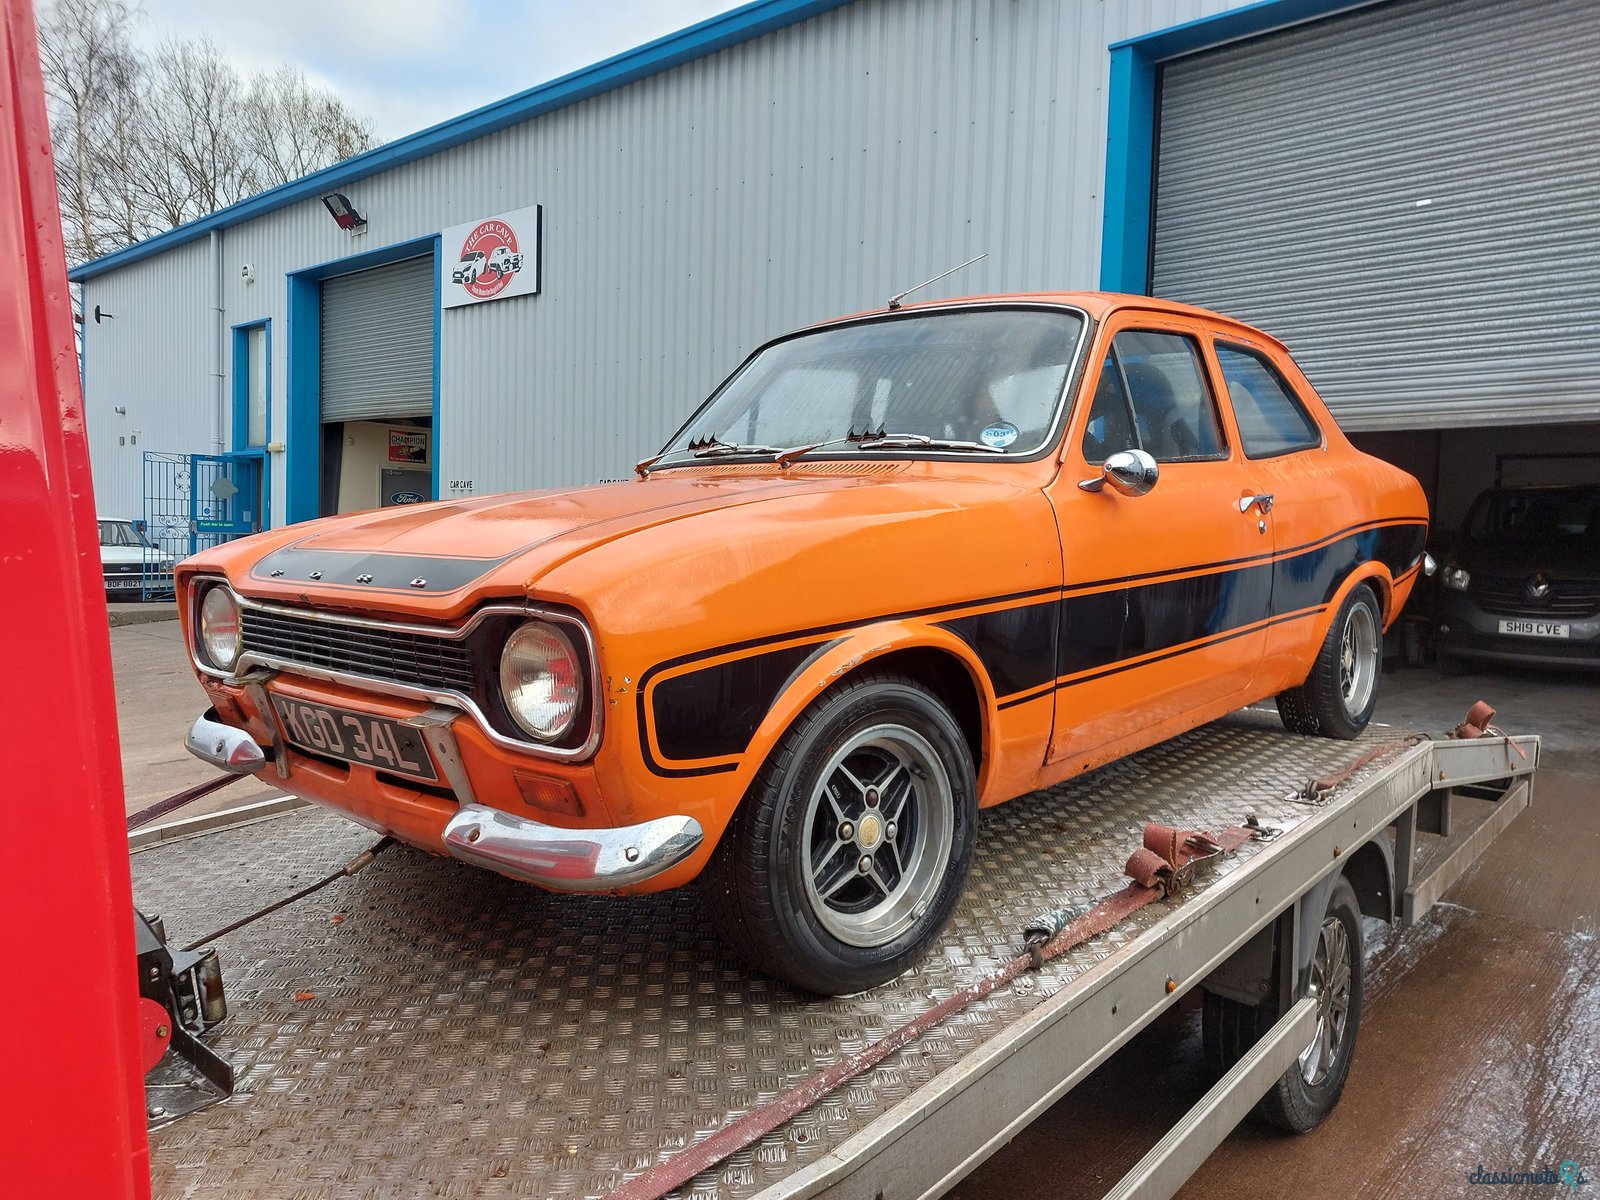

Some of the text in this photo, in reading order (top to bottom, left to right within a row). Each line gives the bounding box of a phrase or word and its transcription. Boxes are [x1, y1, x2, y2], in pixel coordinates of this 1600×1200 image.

[465, 223, 513, 252] THE CAR CAVE
[391, 435, 425, 446] CHAMPION
[449, 480, 473, 489] CAR CAVE
[396, 493, 420, 504] Ford
[1506, 621, 1561, 635] SH19 CVE
[281, 700, 421, 772] KGD 34L
